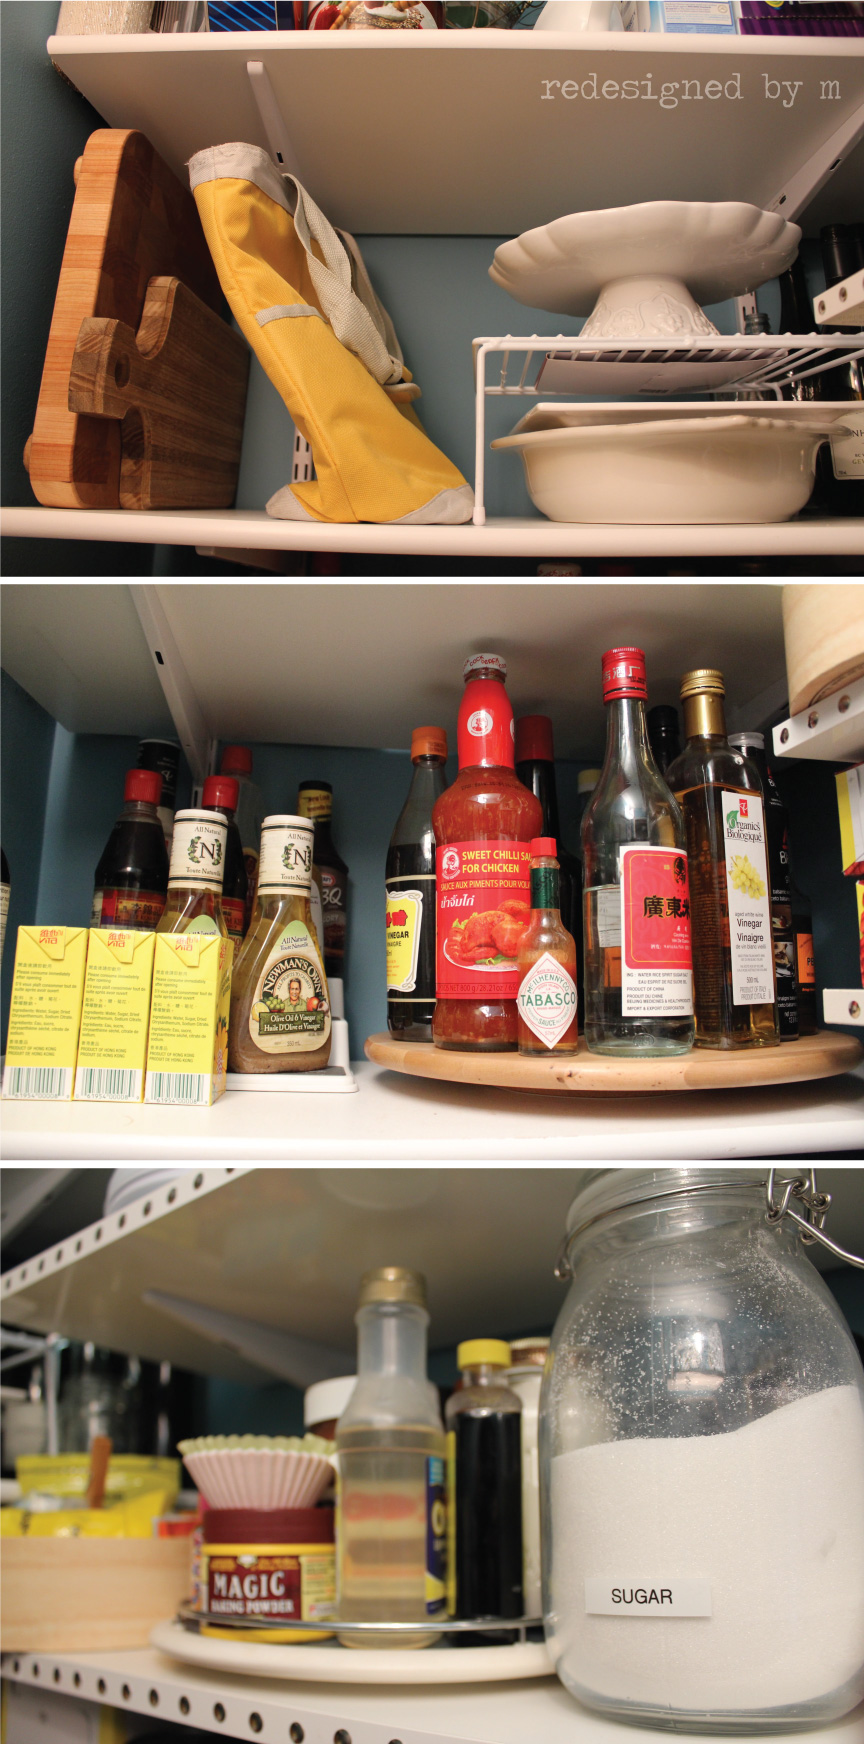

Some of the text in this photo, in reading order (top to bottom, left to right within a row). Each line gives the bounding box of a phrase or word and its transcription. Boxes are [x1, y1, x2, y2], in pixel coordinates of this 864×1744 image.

[200, 842, 215, 859] N
[462, 850, 491, 860] SWEET
[493, 851, 519, 860] CHILLI
[293, 849, 308, 866] N
[462, 864, 519, 873] FOR CHICKEN
[441, 882, 454, 891] SAUCE
[469, 880, 498, 888] PIMENTS
[737, 919, 762, 929] Vinegar
[737, 933, 764, 943] Vinaigre
[263, 958, 322, 993] NEWMAN'S OWN
[521, 992, 576, 1006] TABASCO
[299, 1014, 316, 1023] Vinegar
[303, 1022, 320, 1031] Vinaigre
[213, 1570, 285, 1599] MAGIC
[611, 1588, 673, 1604] SUGAR
[246, 1599, 294, 1614] POWDER
